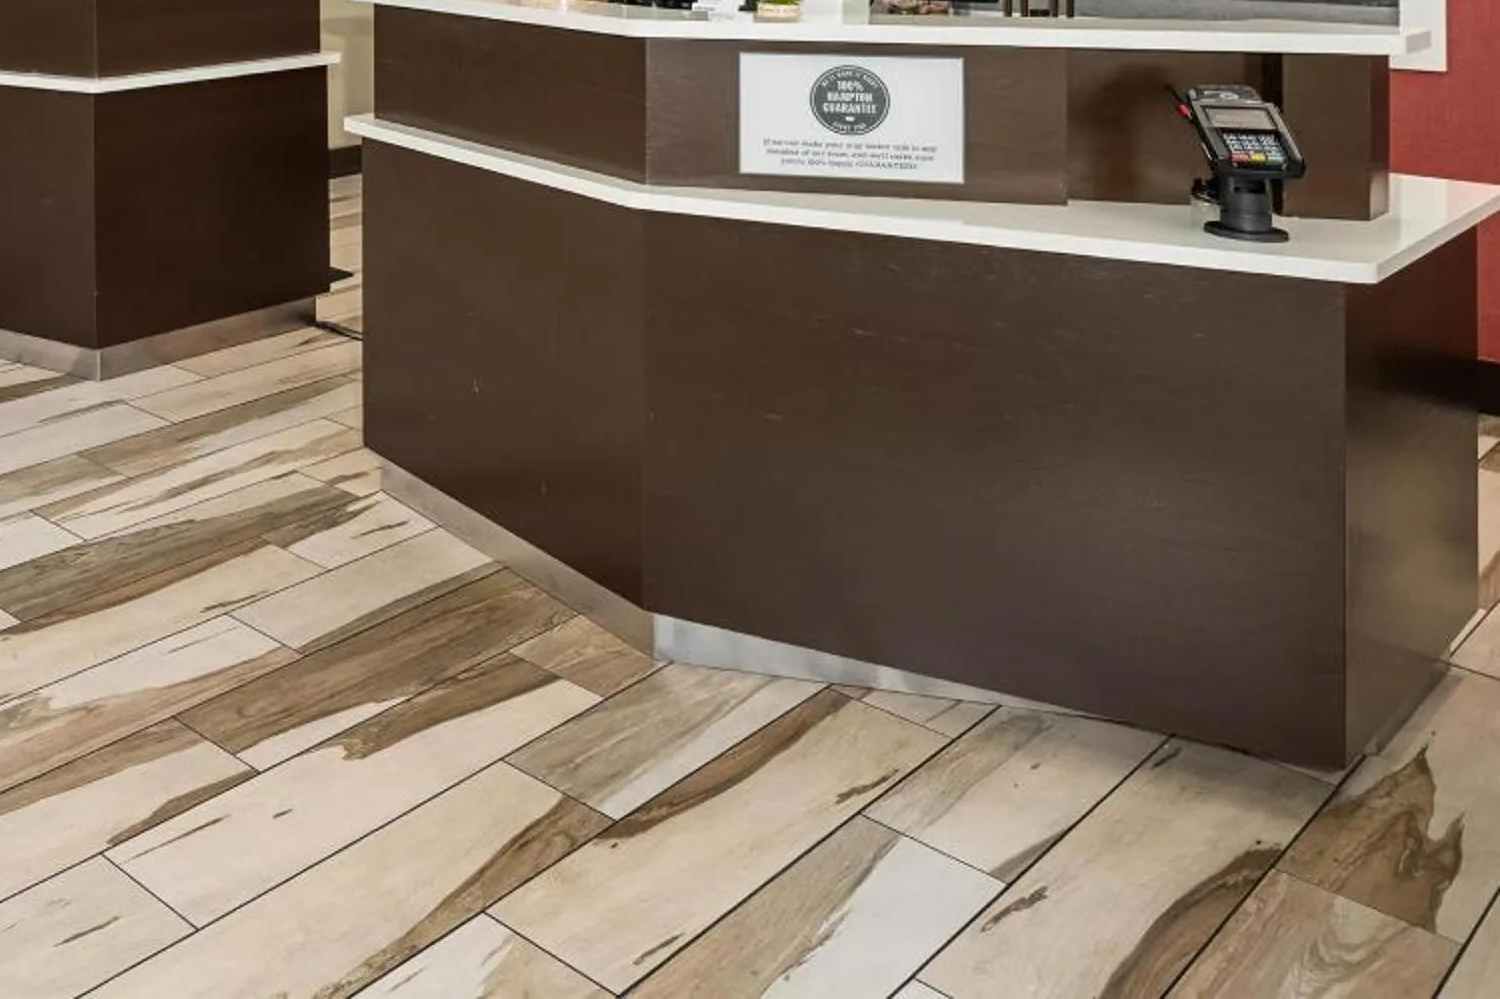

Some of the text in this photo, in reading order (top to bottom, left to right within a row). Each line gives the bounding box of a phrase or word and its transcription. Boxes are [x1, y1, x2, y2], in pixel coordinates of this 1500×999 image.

[837, 80, 864, 91] 100%
[827, 91, 873, 102] HAMPTON
[823, 102, 877, 114] GUARANTEE
